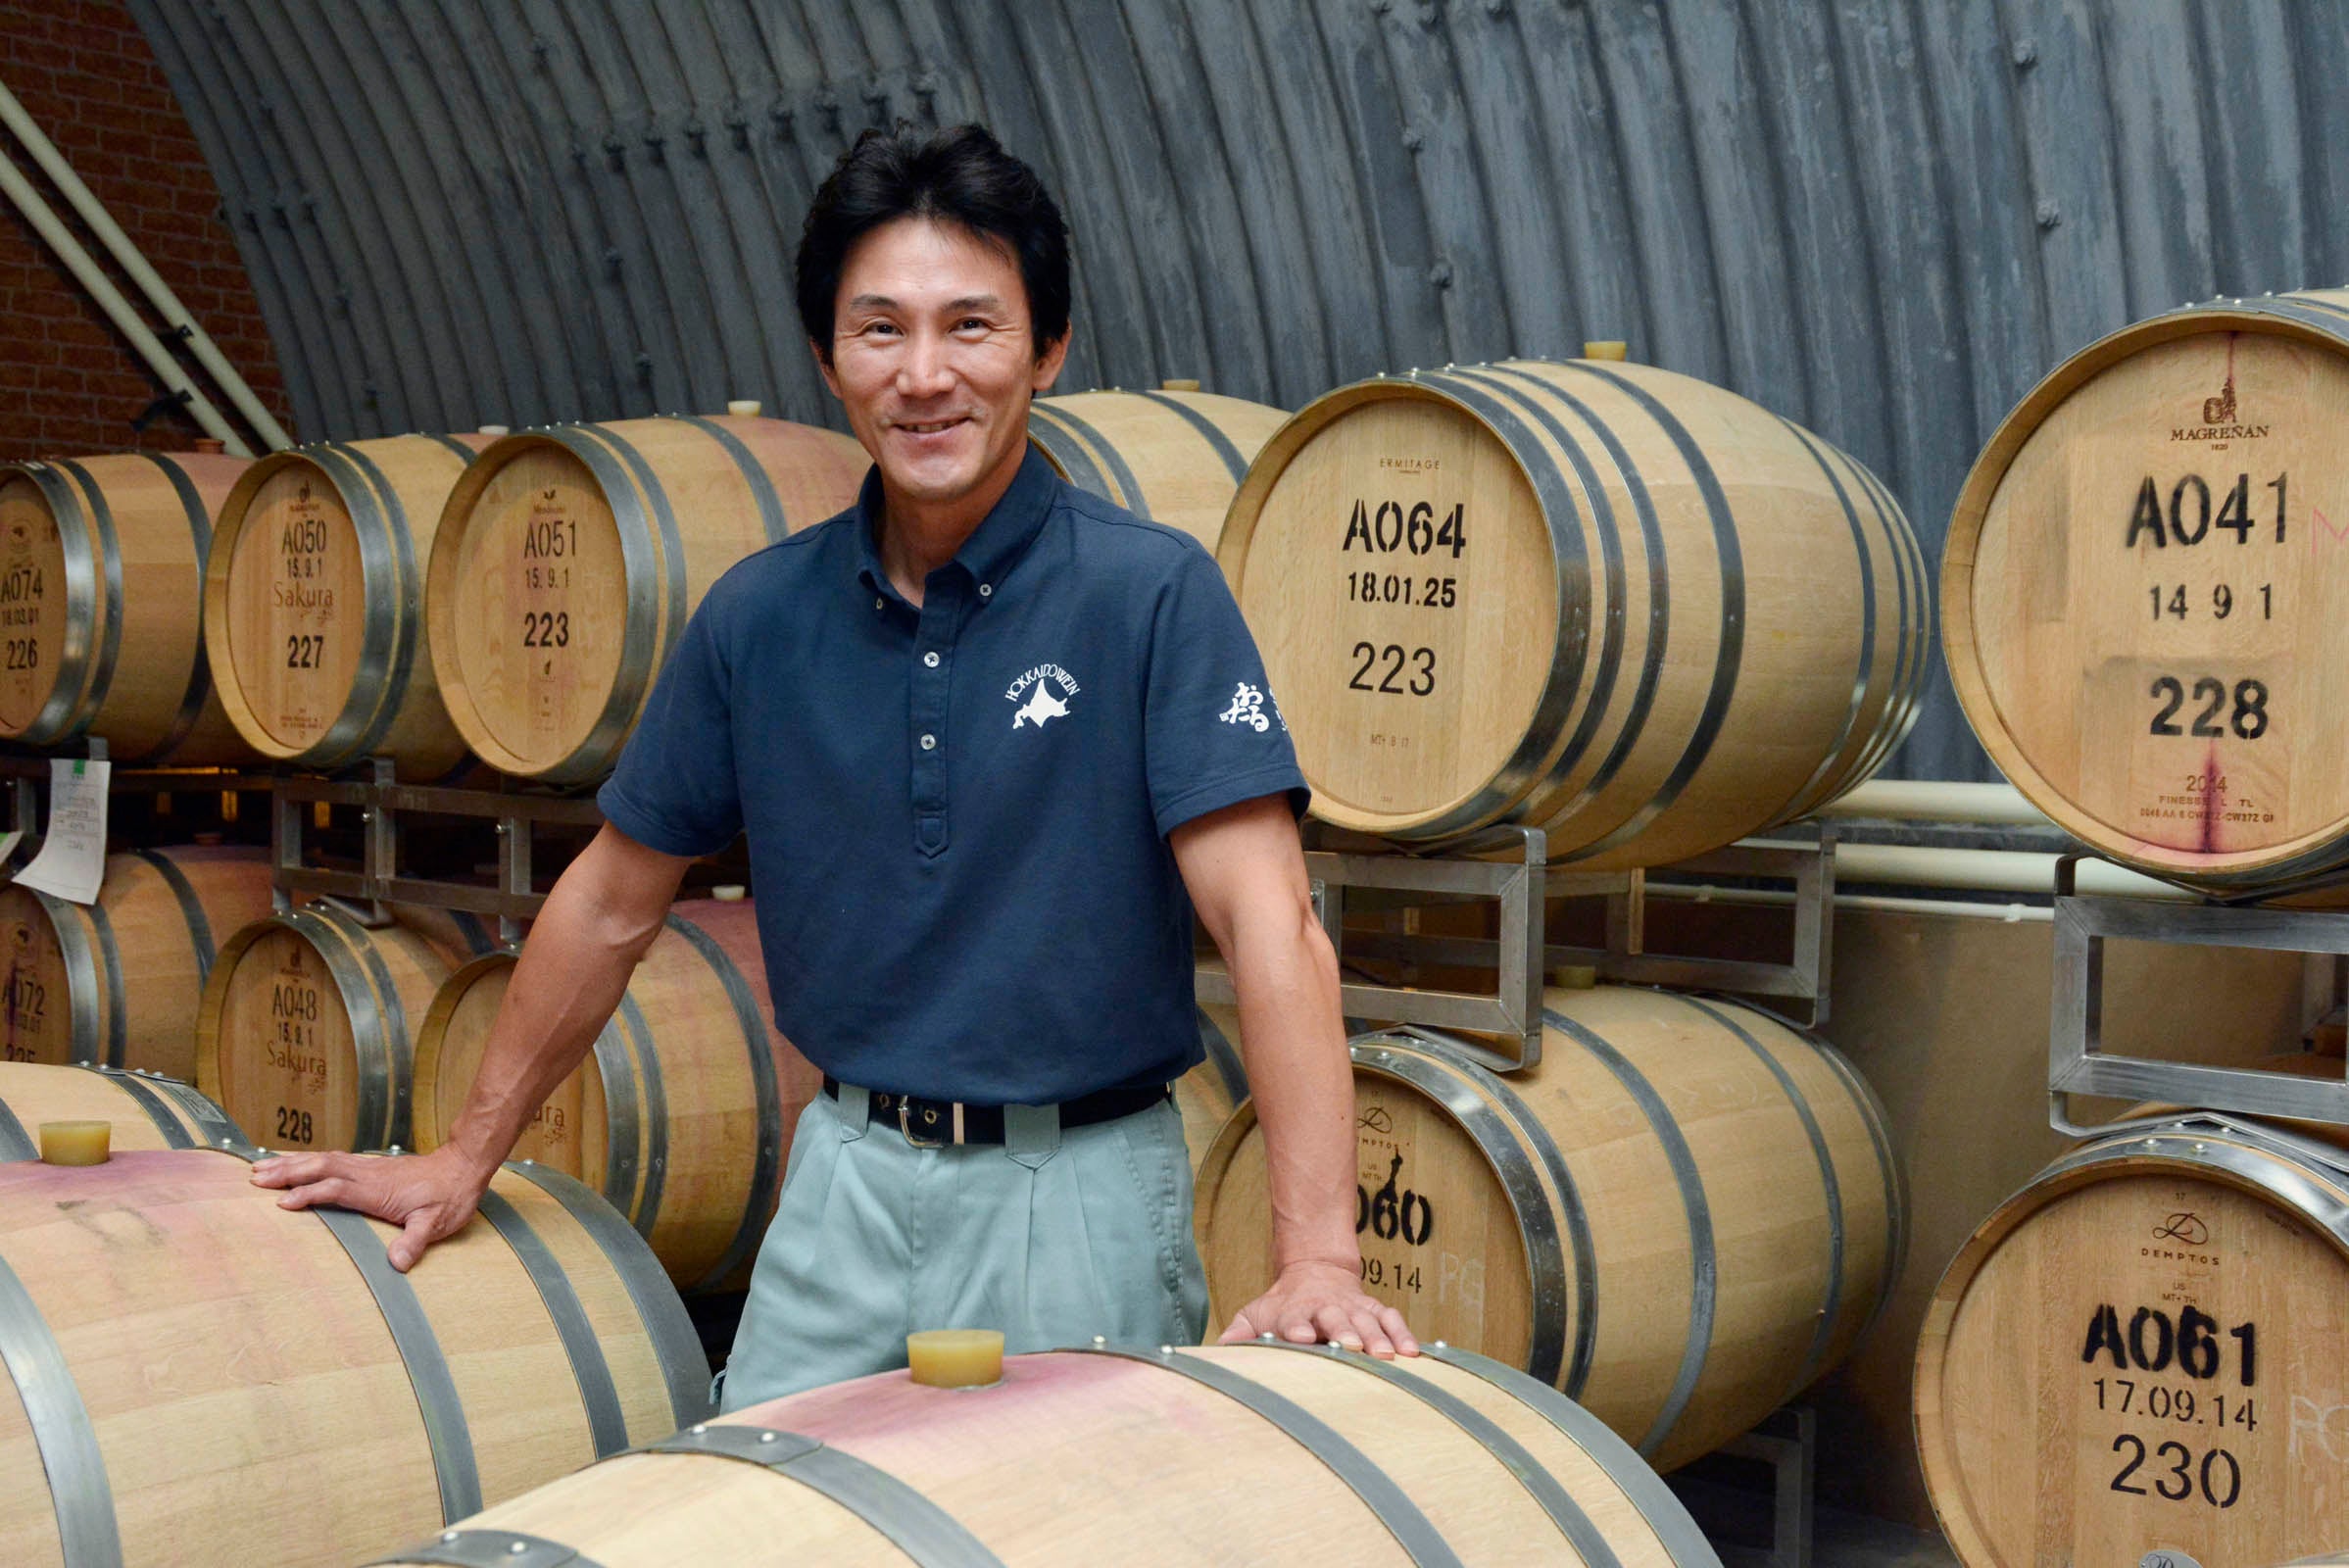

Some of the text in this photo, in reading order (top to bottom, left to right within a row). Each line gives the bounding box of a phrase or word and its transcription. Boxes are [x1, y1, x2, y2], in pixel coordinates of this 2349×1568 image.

[1379, 458, 1441, 470] ERMITAGE
[1343, 498, 1466, 559] A064
[2126, 471, 2288, 548] A041
[281, 519, 326, 555] A050
[523, 520, 576, 559] A051
[1, 569, 43, 604] A074
[273, 580, 333, 609] Sakura
[1348, 571, 1457, 609] 18.01.25
[523, 612, 570, 648] 223
[7, 638, 38, 670] 226
[287, 634, 324, 668] 227
[1349, 641, 1437, 697] 223
[2149, 677, 2269, 740] 228
[272, 984, 318, 1021] A048
[267, 1039, 327, 1077] Sakura
[276, 1105, 314, 1146] 228
[2141, 1248, 2220, 1265] DEMPTOS
[2173, 1282, 2185, 1291] US
[2082, 1304, 2256, 1387] A061
[2093, 1379, 2257, 1432] 17.09.14
[2111, 1434, 2241, 1508] 230
